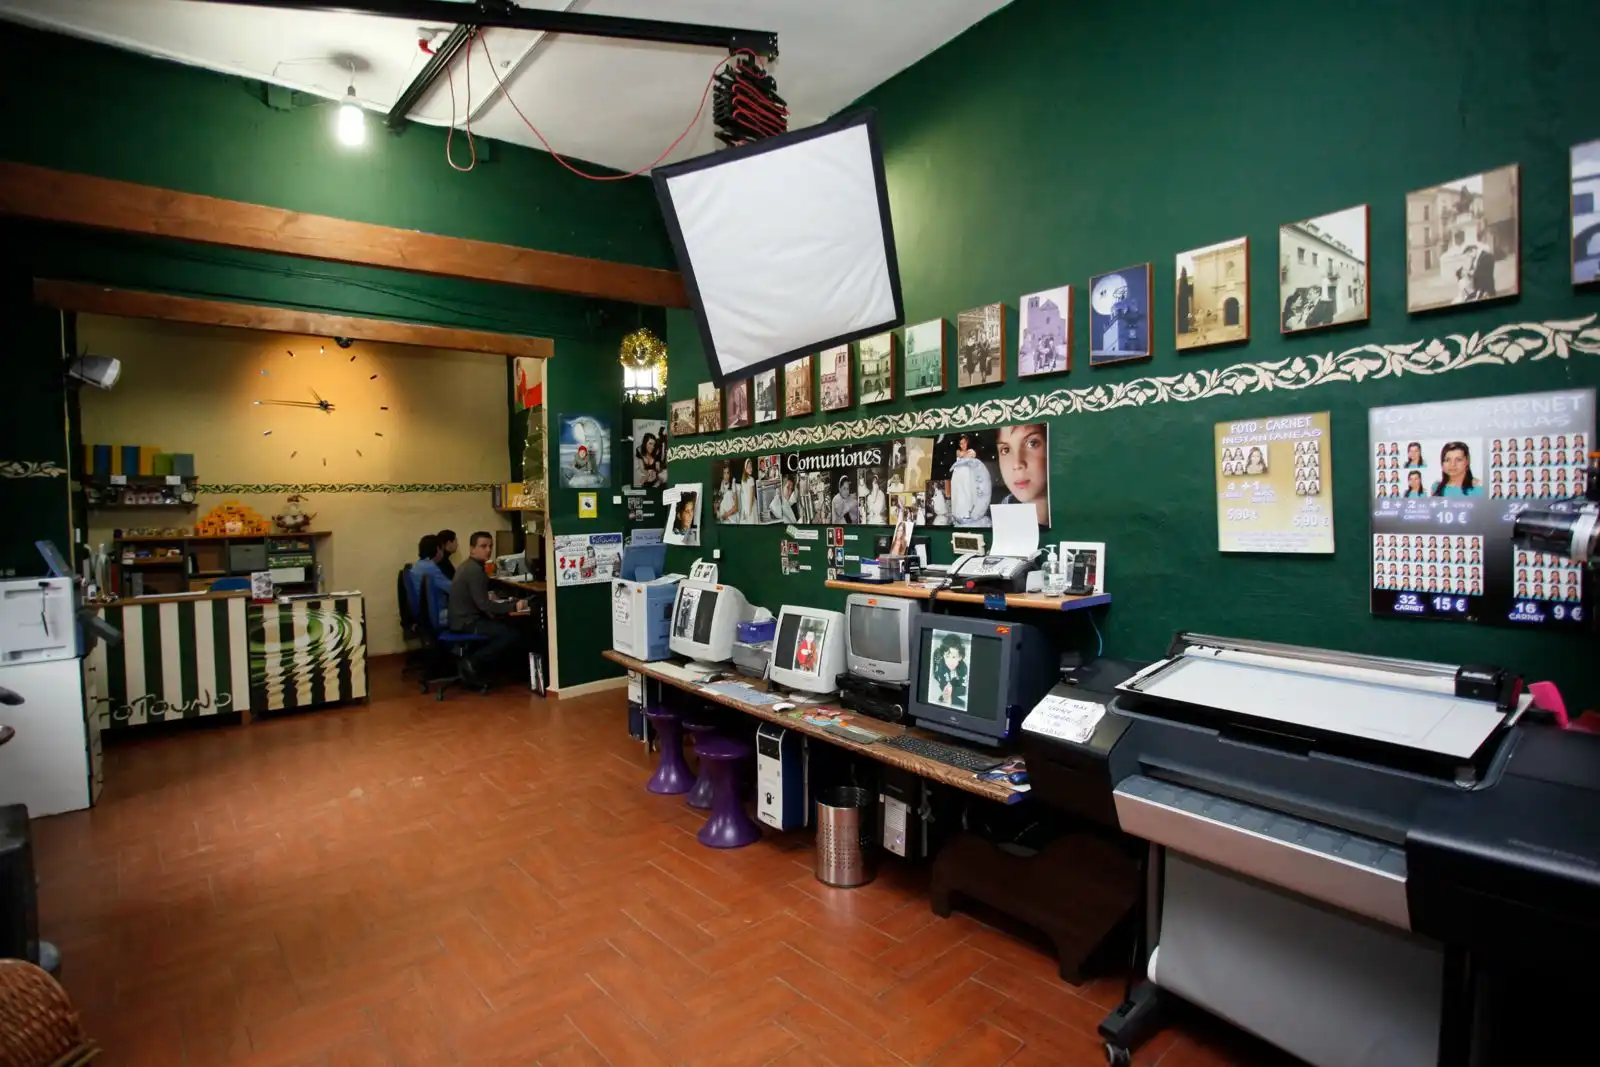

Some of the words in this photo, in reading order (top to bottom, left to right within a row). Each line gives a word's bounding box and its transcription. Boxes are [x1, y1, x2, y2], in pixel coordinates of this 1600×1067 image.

[1231, 422, 1257, 434] FOTO
[1265, 416, 1312, 431] CARNET
[787, 447, 881, 472] Comuniones
[1381, 500, 1391, 510] 8
[1407, 500, 1417, 509] 2
[1440, 499, 1449, 509] 1
[1436, 511, 1454, 524] 10
[1393, 603, 1425, 613] CARNET
[1399, 594, 1418, 605] 32
[1433, 596, 1451, 611] 15
[1508, 612, 1545, 623] CARNET
[1515, 602, 1537, 614] 16
[1553, 605, 1565, 620] 9
